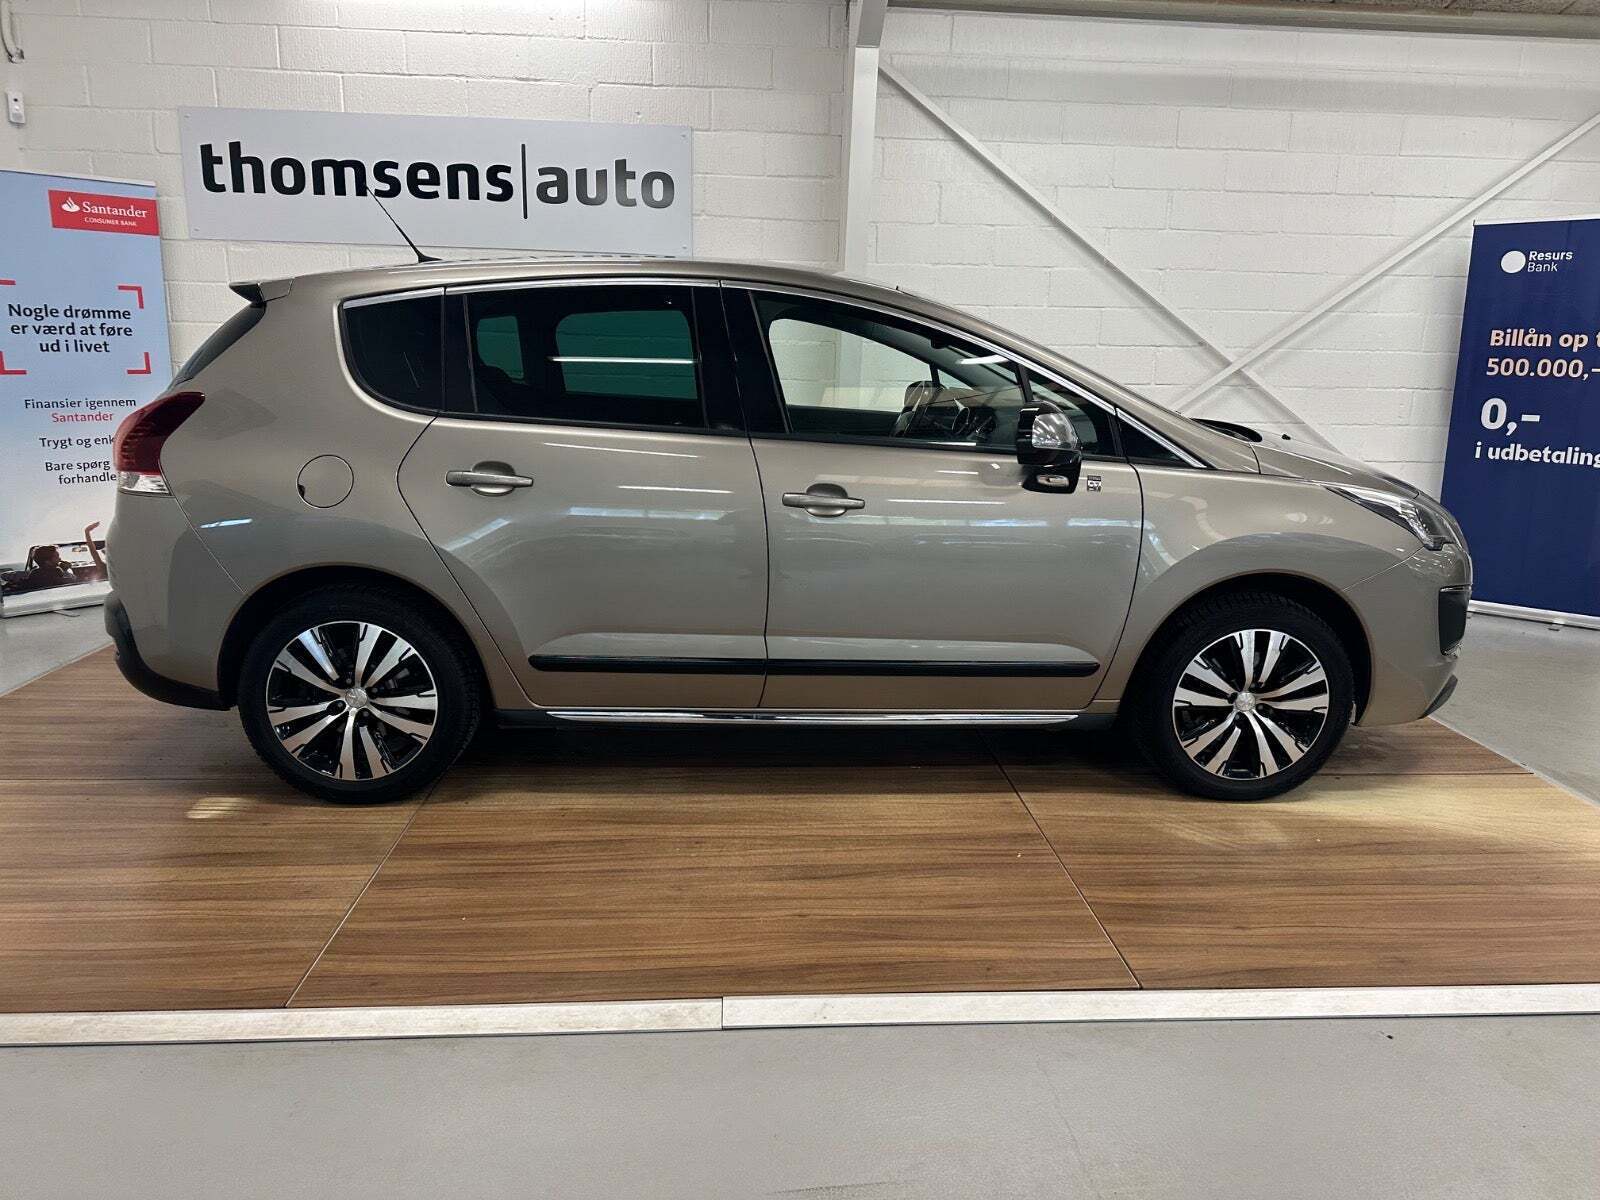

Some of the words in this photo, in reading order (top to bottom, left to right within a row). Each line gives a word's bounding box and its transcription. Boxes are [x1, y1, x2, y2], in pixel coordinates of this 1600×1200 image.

[200, 141, 514, 202] thomsens
[535, 158, 676, 209] auto
[82, 201, 147, 218] Santander
[84, 216, 119, 225] CONSUMER
[1528, 251, 1573, 261] Resurs
[1527, 262, 1558, 272] Bank
[8, 303, 59, 321] Nogle
[63, 305, 131, 320] drømme
[10, 324, 28, 335] er
[32, 322, 75, 336] værd
[80, 324, 96, 336] at
[100, 323, 133, 337] føre
[39, 340, 60, 353] ud
[65, 340, 70, 353] i
[74, 340, 110, 353] livet
[1490, 328, 1552, 347] Billån
[1558, 333, 1589, 352] op
[24, 397, 82, 409] Finansier
[86, 398, 136, 410] igennem
[51, 412, 114, 423] Santander
[39, 437, 72, 449] Trygt
[76, 437, 92, 448] og
[1474, 441, 1483, 459] i
[45, 460, 73, 472] Bare
[76, 460, 111, 471] spørg
[58, 471, 117, 484] forhandle
